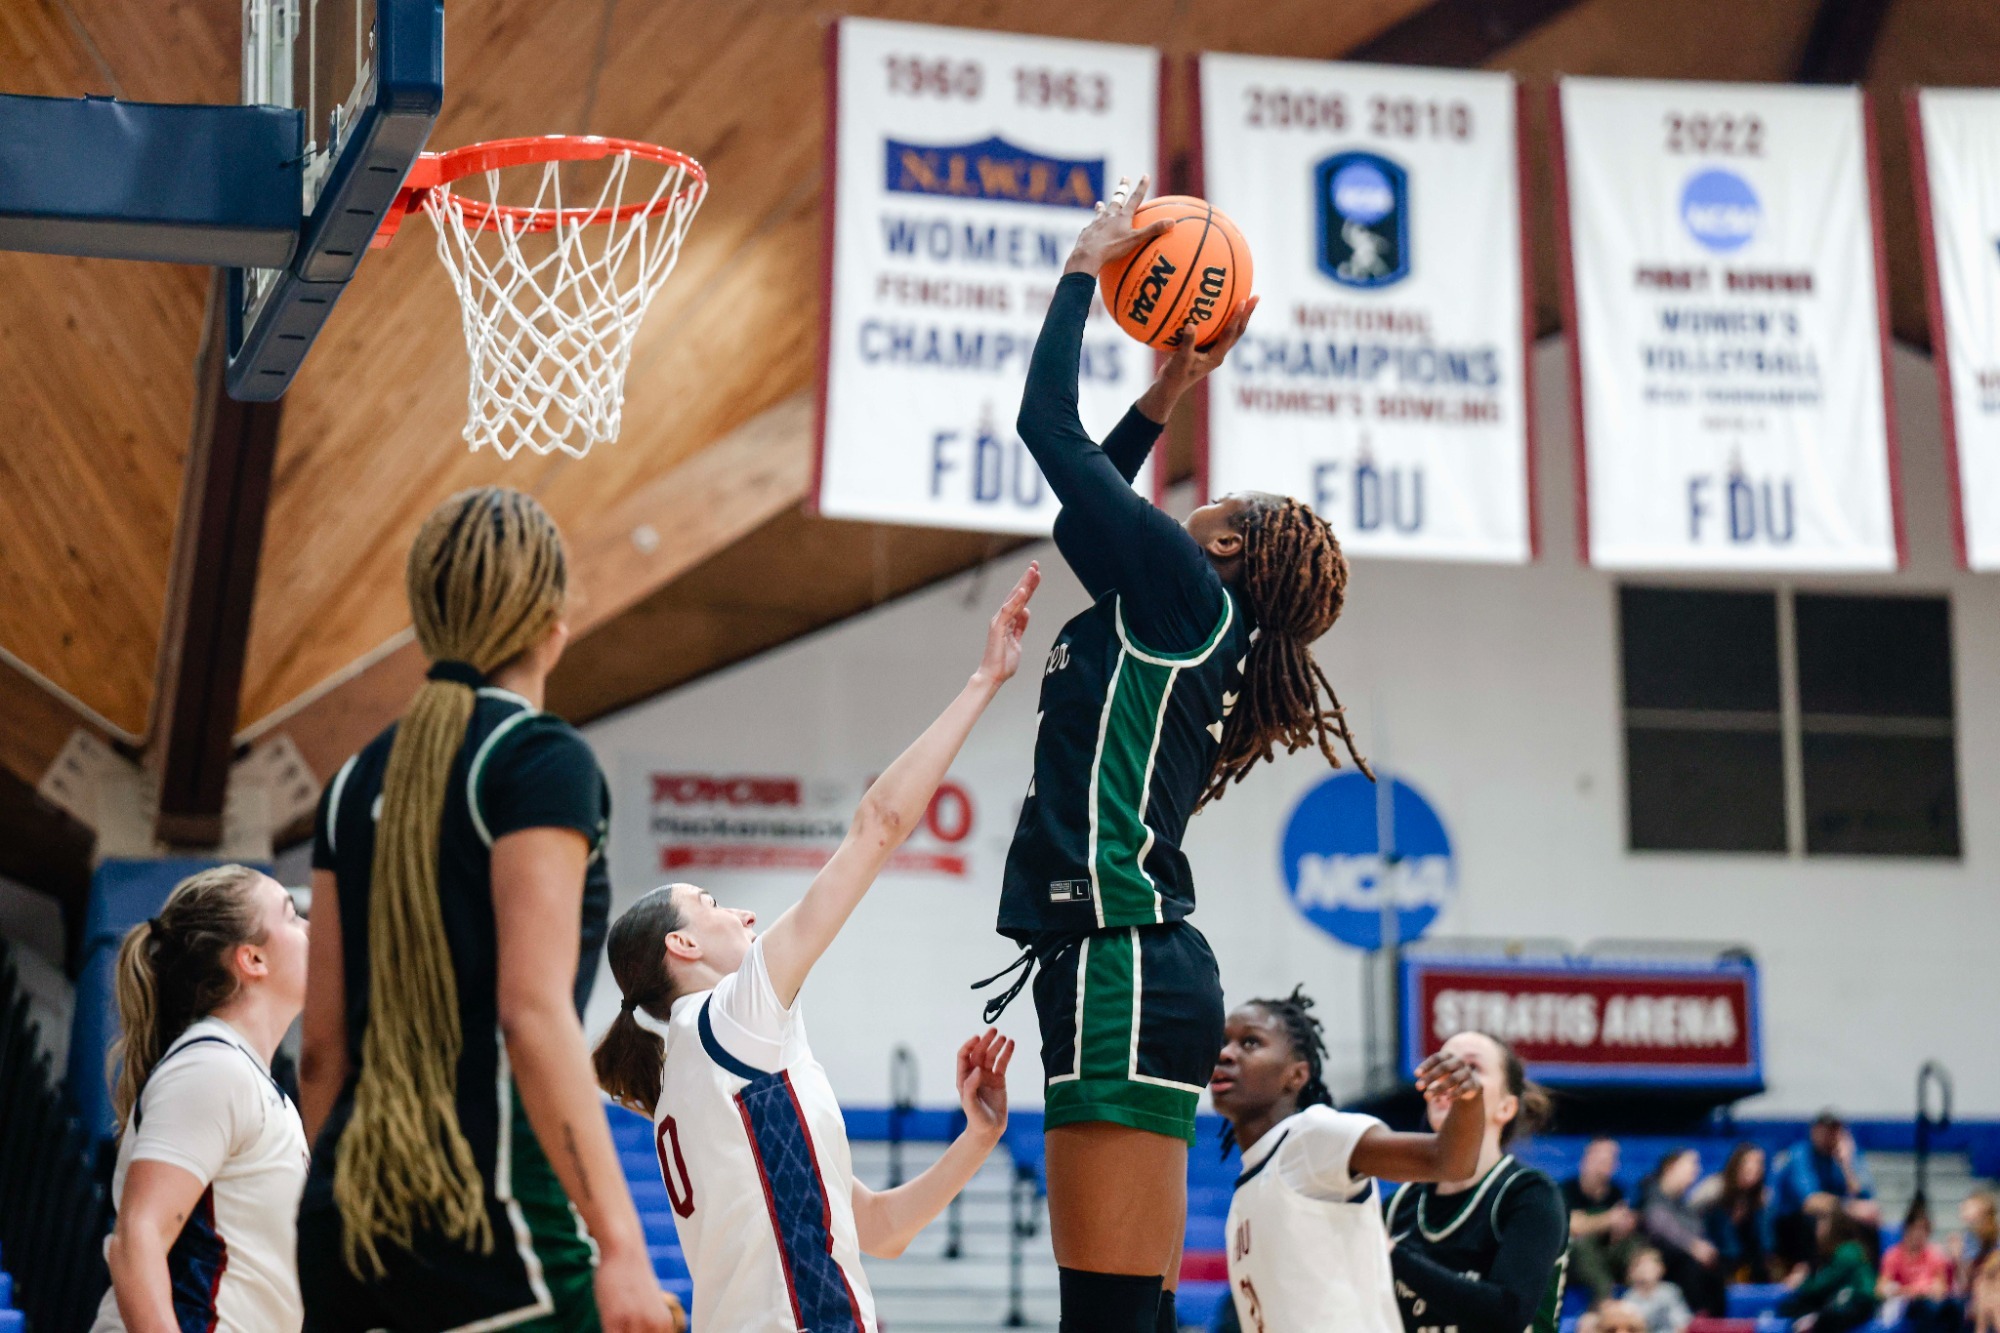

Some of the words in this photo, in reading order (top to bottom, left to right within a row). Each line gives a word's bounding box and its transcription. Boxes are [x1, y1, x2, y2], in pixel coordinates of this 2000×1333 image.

[886, 54, 983, 102] 1960
[1015, 65, 1113, 114] 1963
[1244, 86, 1347, 133] 2006
[1665, 110, 1764, 156] 2022
[1127, 254, 1177, 326] NCAA
[1291, 304, 1433, 336] NATIONAL
[1231, 335, 1501, 388] CHAMPIONS
[1237, 385, 1364, 417] WOMEN'S
[1376, 394, 1501, 425] BOWLING
[931, 428, 1045, 510] FDU
[1312, 460, 1426, 534] FDU
[1688, 474, 1793, 544] FDU
[1076, 885, 1083, 895] L
[1295, 854, 1451, 910] NCAA
[1433, 989, 1598, 1047] STRATIS
[1601, 994, 1739, 1048] ARENA
[656, 1114, 695, 1219] 0
